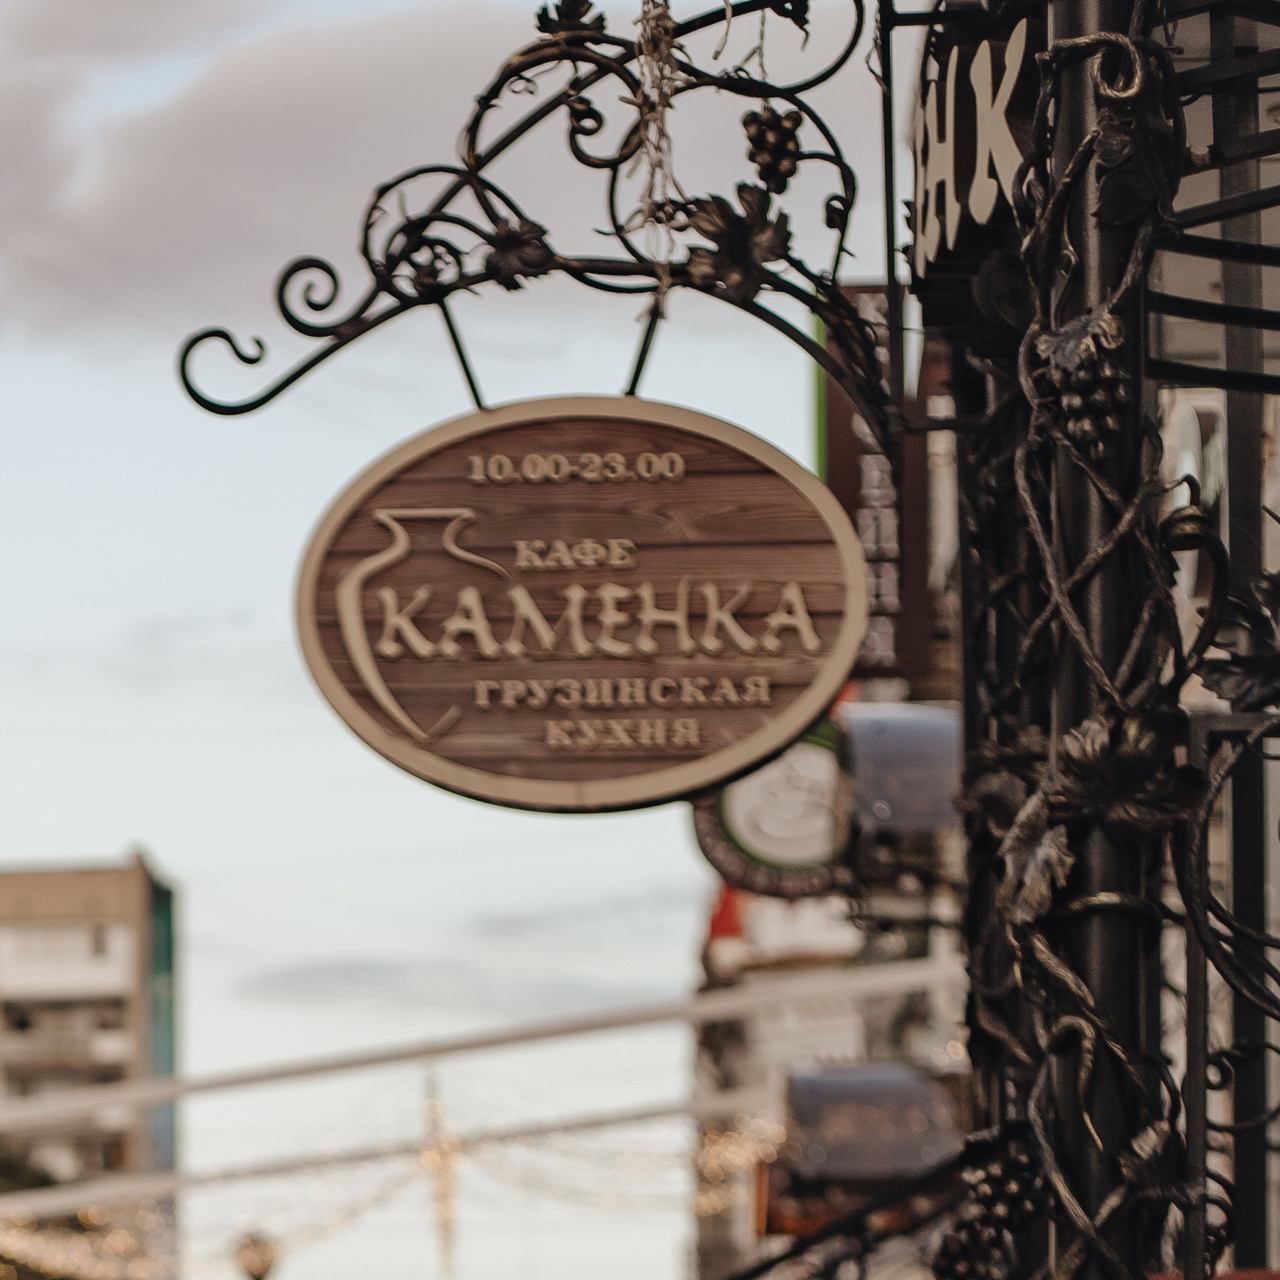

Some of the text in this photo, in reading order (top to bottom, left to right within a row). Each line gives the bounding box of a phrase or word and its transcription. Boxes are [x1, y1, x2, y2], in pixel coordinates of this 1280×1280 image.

[469, 452, 685, 483] 10.00-23.00
[514, 538, 638, 570] КАФЕ
[377, 576, 821, 659] КАМЕНКА
[473, 675, 772, 710] ГРУЗИНСКАЯ
[544, 717, 701, 748] КУХНЯ
